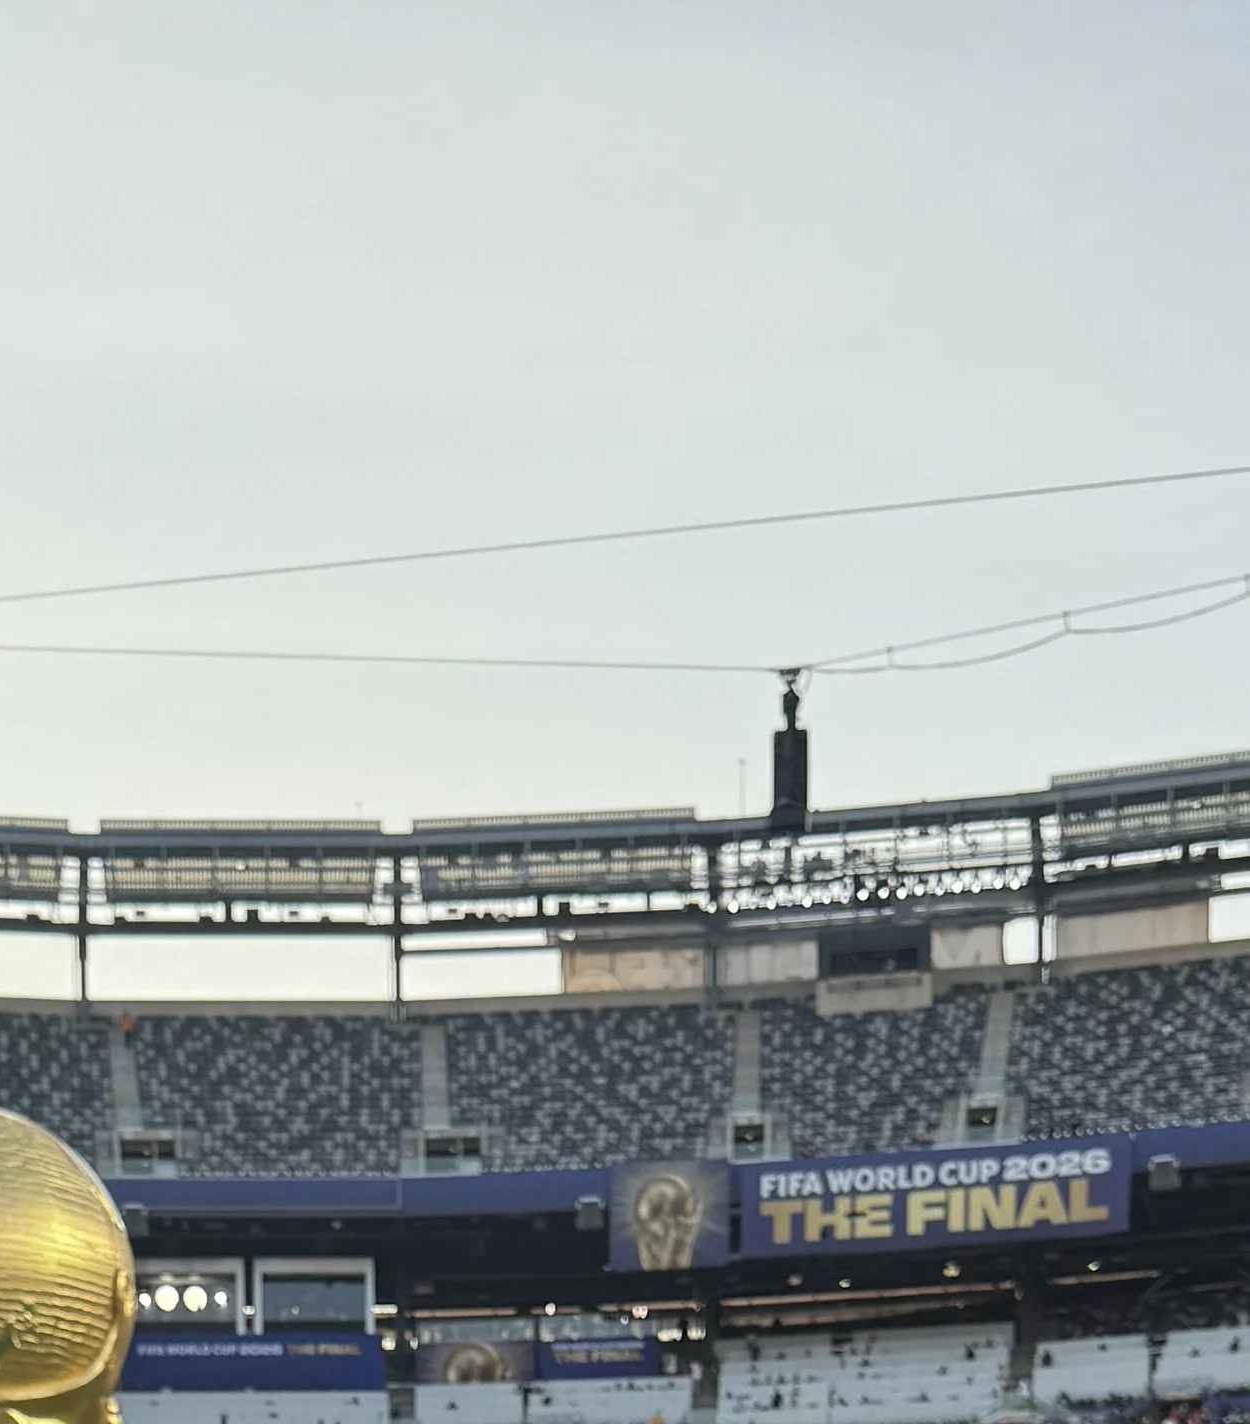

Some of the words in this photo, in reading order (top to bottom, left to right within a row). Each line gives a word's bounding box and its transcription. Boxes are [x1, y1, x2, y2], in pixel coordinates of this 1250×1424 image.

[759, 1171, 825, 1199] FIFA
[827, 1162, 935, 1194] WORLD
[937, 1158, 1000, 1186] CUP
[1001, 1148, 1113, 1181] 2026
[759, 1193, 895, 1245] THE
[904, 1178, 1111, 1237] FINAL
